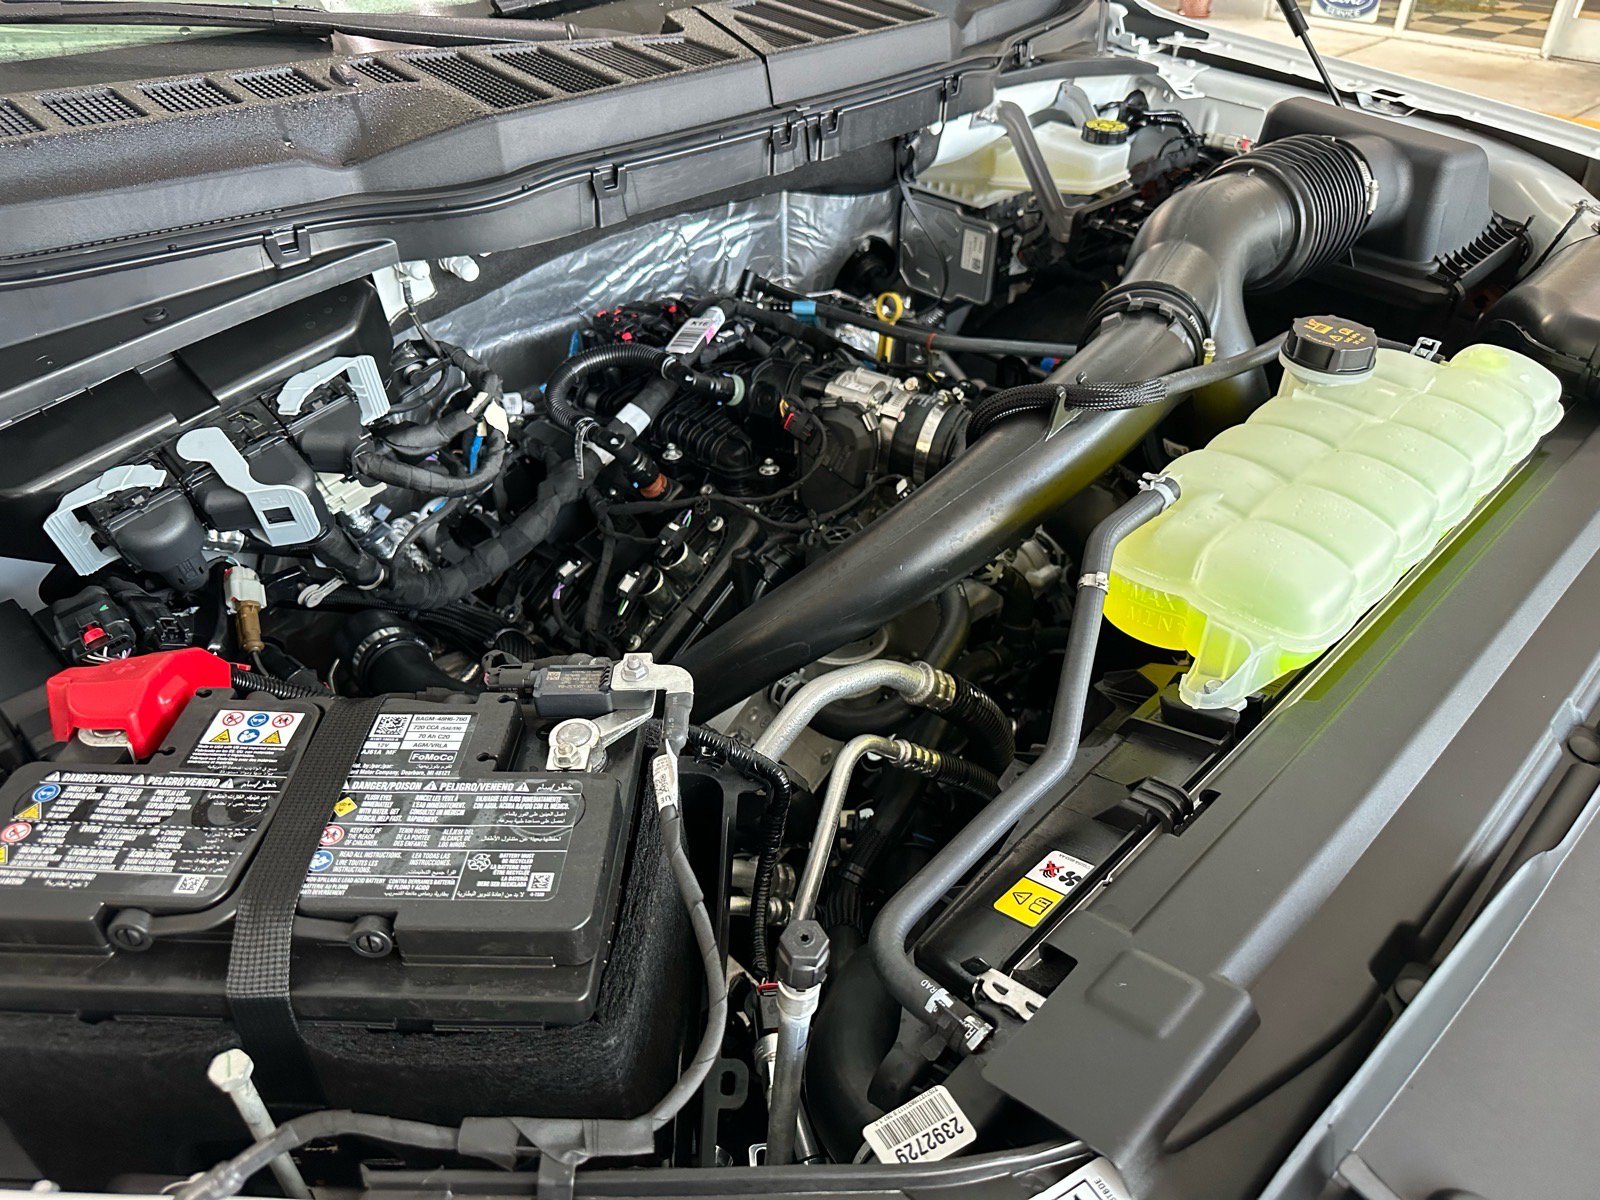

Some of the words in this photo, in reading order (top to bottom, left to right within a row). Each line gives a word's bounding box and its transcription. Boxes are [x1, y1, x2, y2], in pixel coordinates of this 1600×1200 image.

[411, 753, 454, 761] FoMoCo
[61, 772, 133, 784] DANGER/POISON
[146, 776, 221, 788] PELIGRO/VENENO
[351, 781, 423, 790] DANGER/POISON
[439, 782, 514, 791] PELIGRO/VENENO
[920, 979, 938, 994] RAD
[895, 1116, 965, 1164] 2392729
